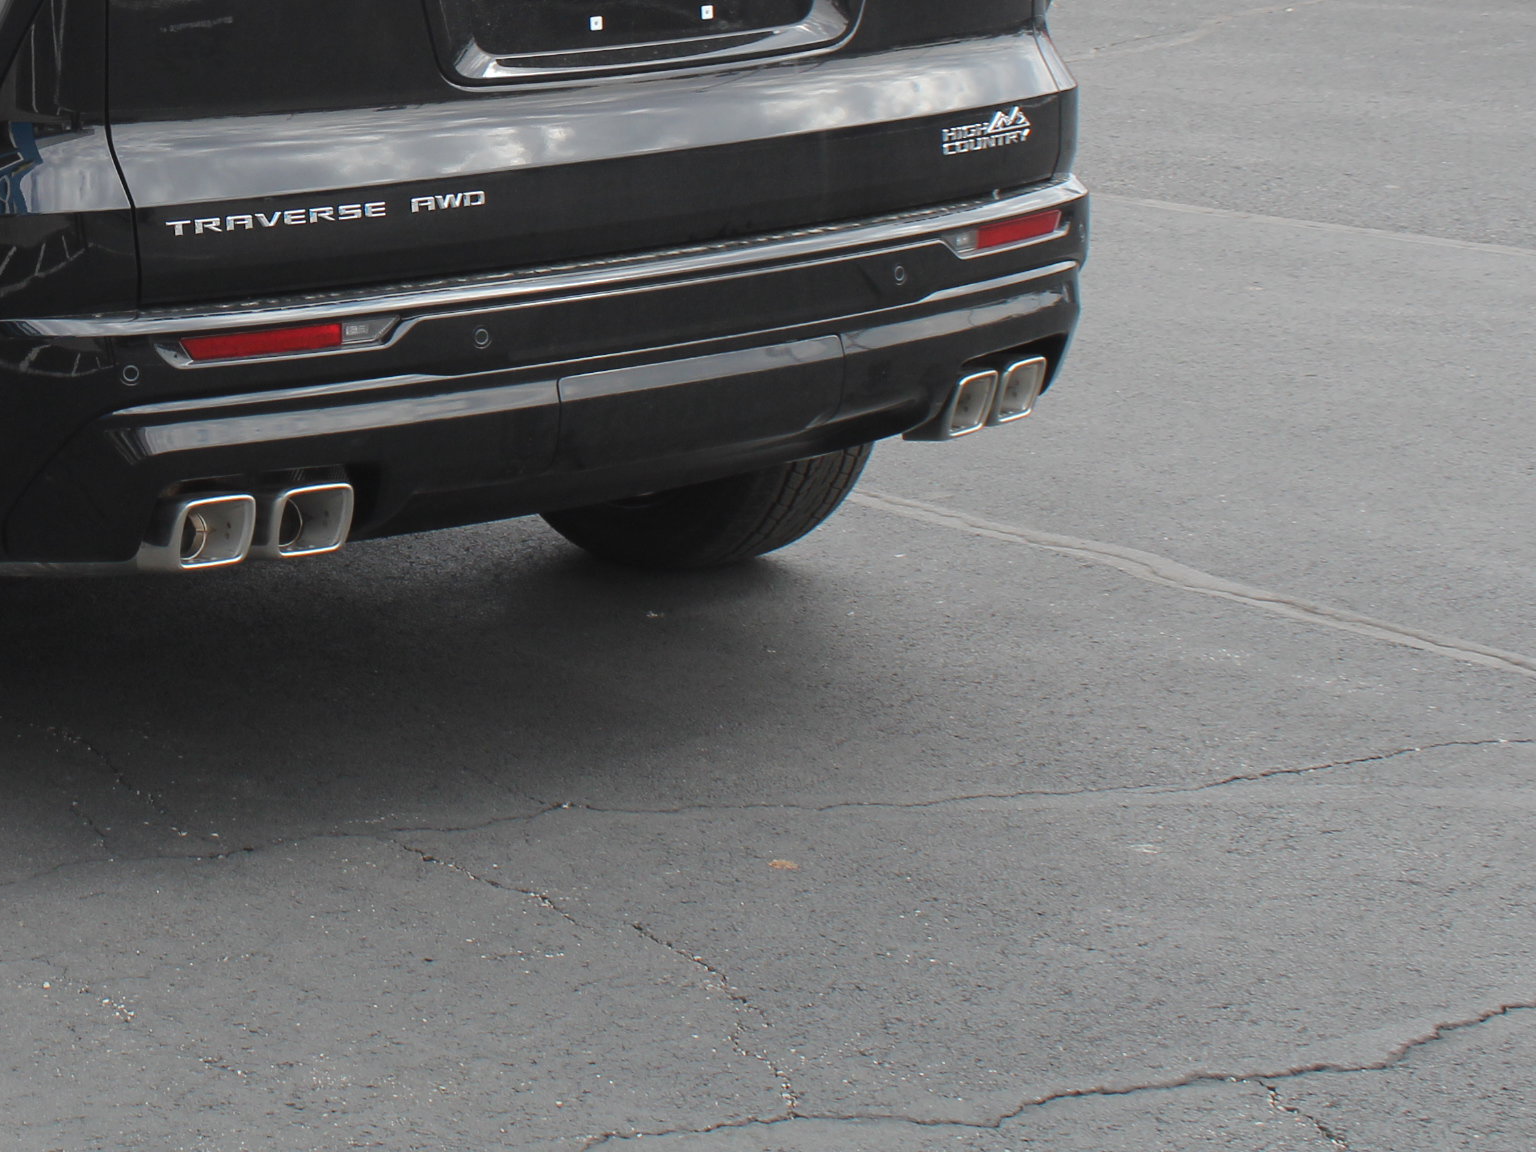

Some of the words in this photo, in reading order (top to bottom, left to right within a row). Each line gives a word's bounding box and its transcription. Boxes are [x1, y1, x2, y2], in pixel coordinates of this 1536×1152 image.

[942, 122, 990, 142] HIGH
[942, 128, 1030, 156] COUNTRY
[165, 201, 386, 236] TRAVERSE
[410, 190, 486, 213] AWD
